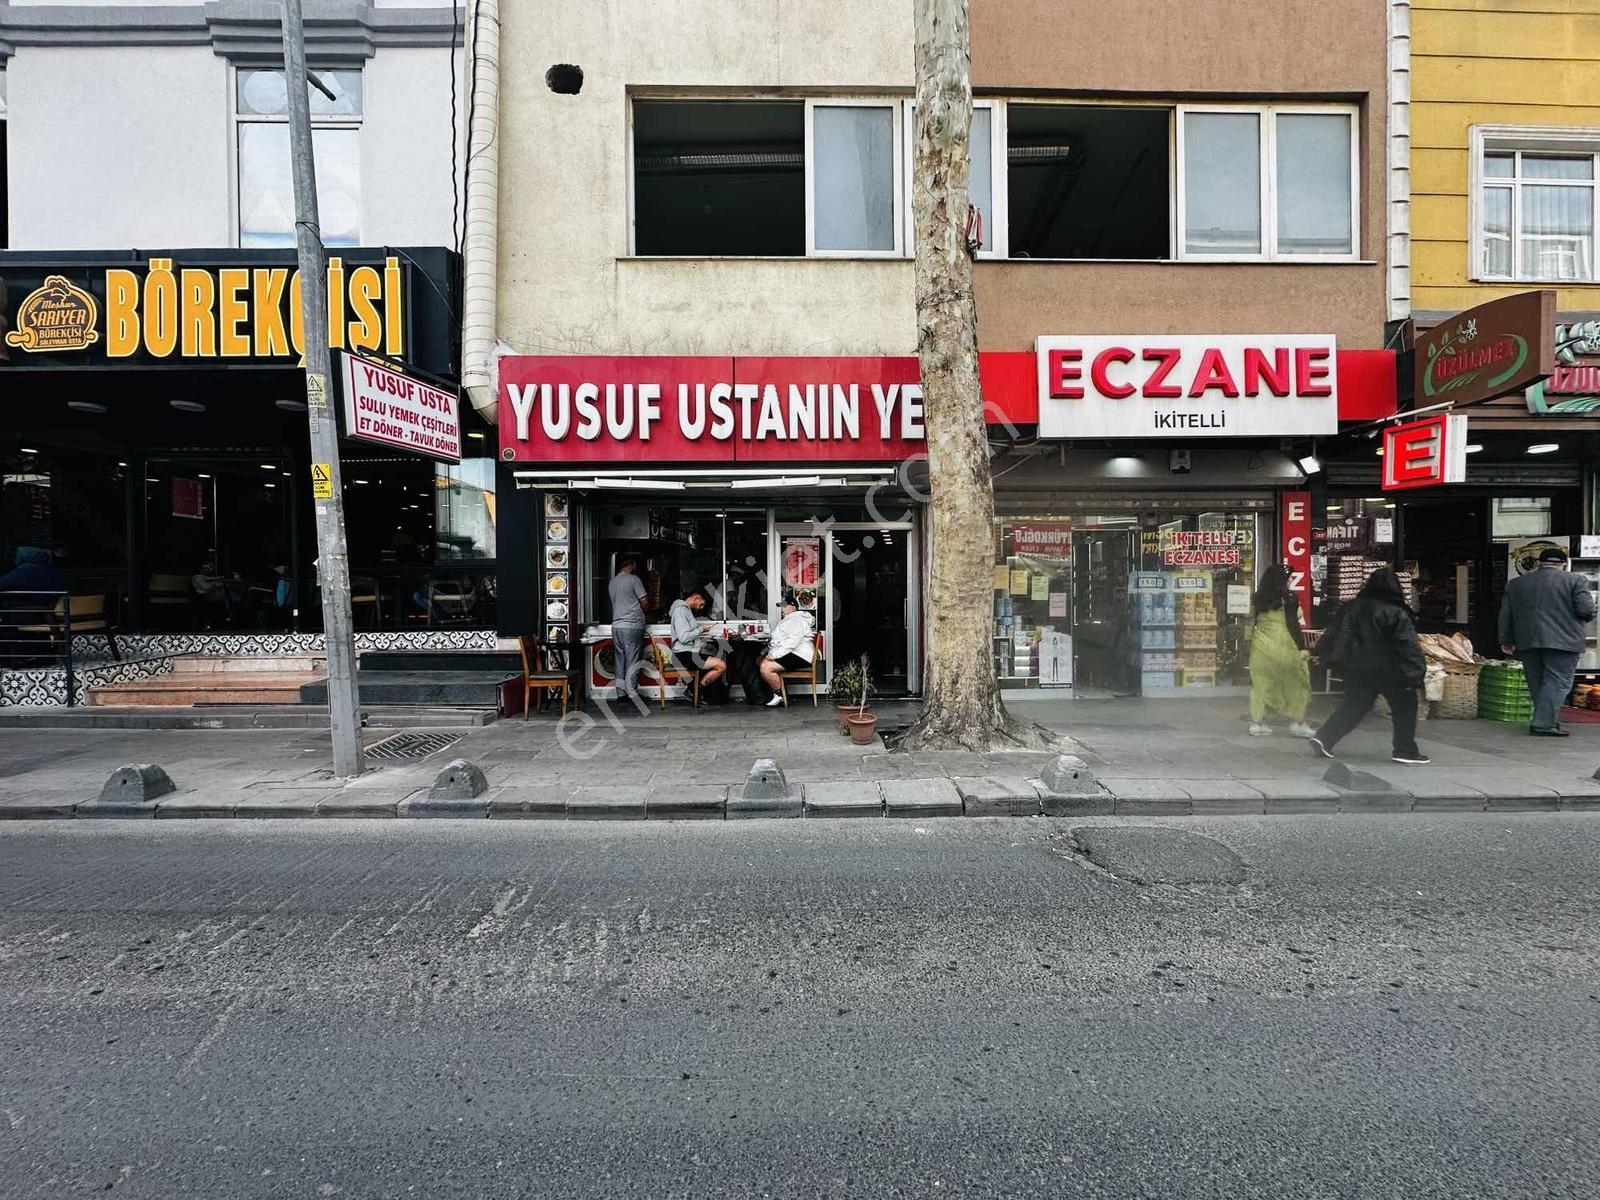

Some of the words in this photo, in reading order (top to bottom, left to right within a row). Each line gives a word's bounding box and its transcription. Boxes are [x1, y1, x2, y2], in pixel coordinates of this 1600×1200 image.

[30, 309, 87, 327] SARIYER
[363, 366, 414, 401] YUSUF
[419, 387, 452, 415] USTA
[1049, 347, 1332, 400] ECZANE
[360, 396, 386, 415] SULU
[389, 404, 420, 426] YEMEK
[421, 415, 457, 438] ÇEŞİTLERİ
[506, 383, 661, 440] YUSUF
[678, 383, 860, 440] USTANIN
[1154, 410, 1226, 429] İKİTELLİ
[360, 417, 372, 431] ET
[373, 419, 403, 439] DÖNER
[410, 430, 434, 448] TAVUK
[435, 436, 458, 453] DÖNER
[1394, 426, 1439, 481] E
